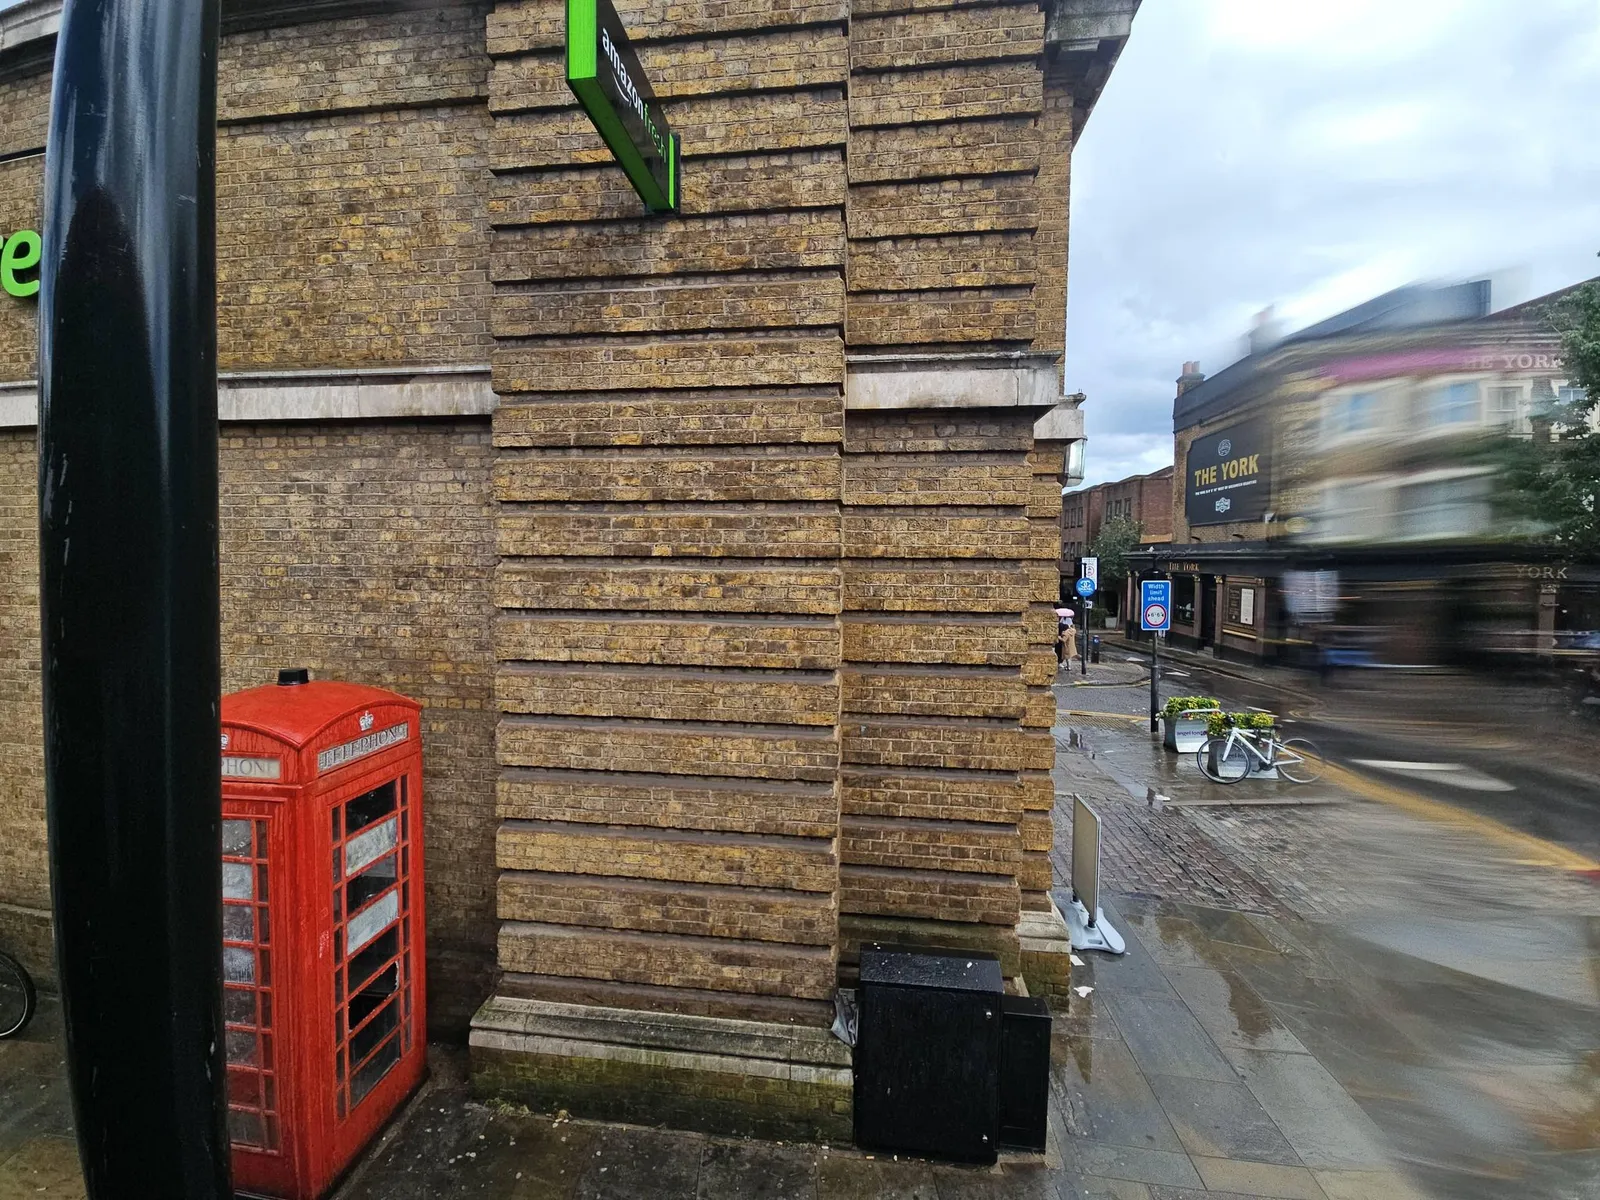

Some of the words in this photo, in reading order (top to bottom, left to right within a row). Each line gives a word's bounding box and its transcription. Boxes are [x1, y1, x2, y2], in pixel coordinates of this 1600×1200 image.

[1194, 465, 1217, 487] THE
[1221, 453, 1260, 480] YORK
[1169, 562, 1180, 571] THE
[1183, 562, 1200, 572] YORK
[1516, 566, 1568, 579] YORK
